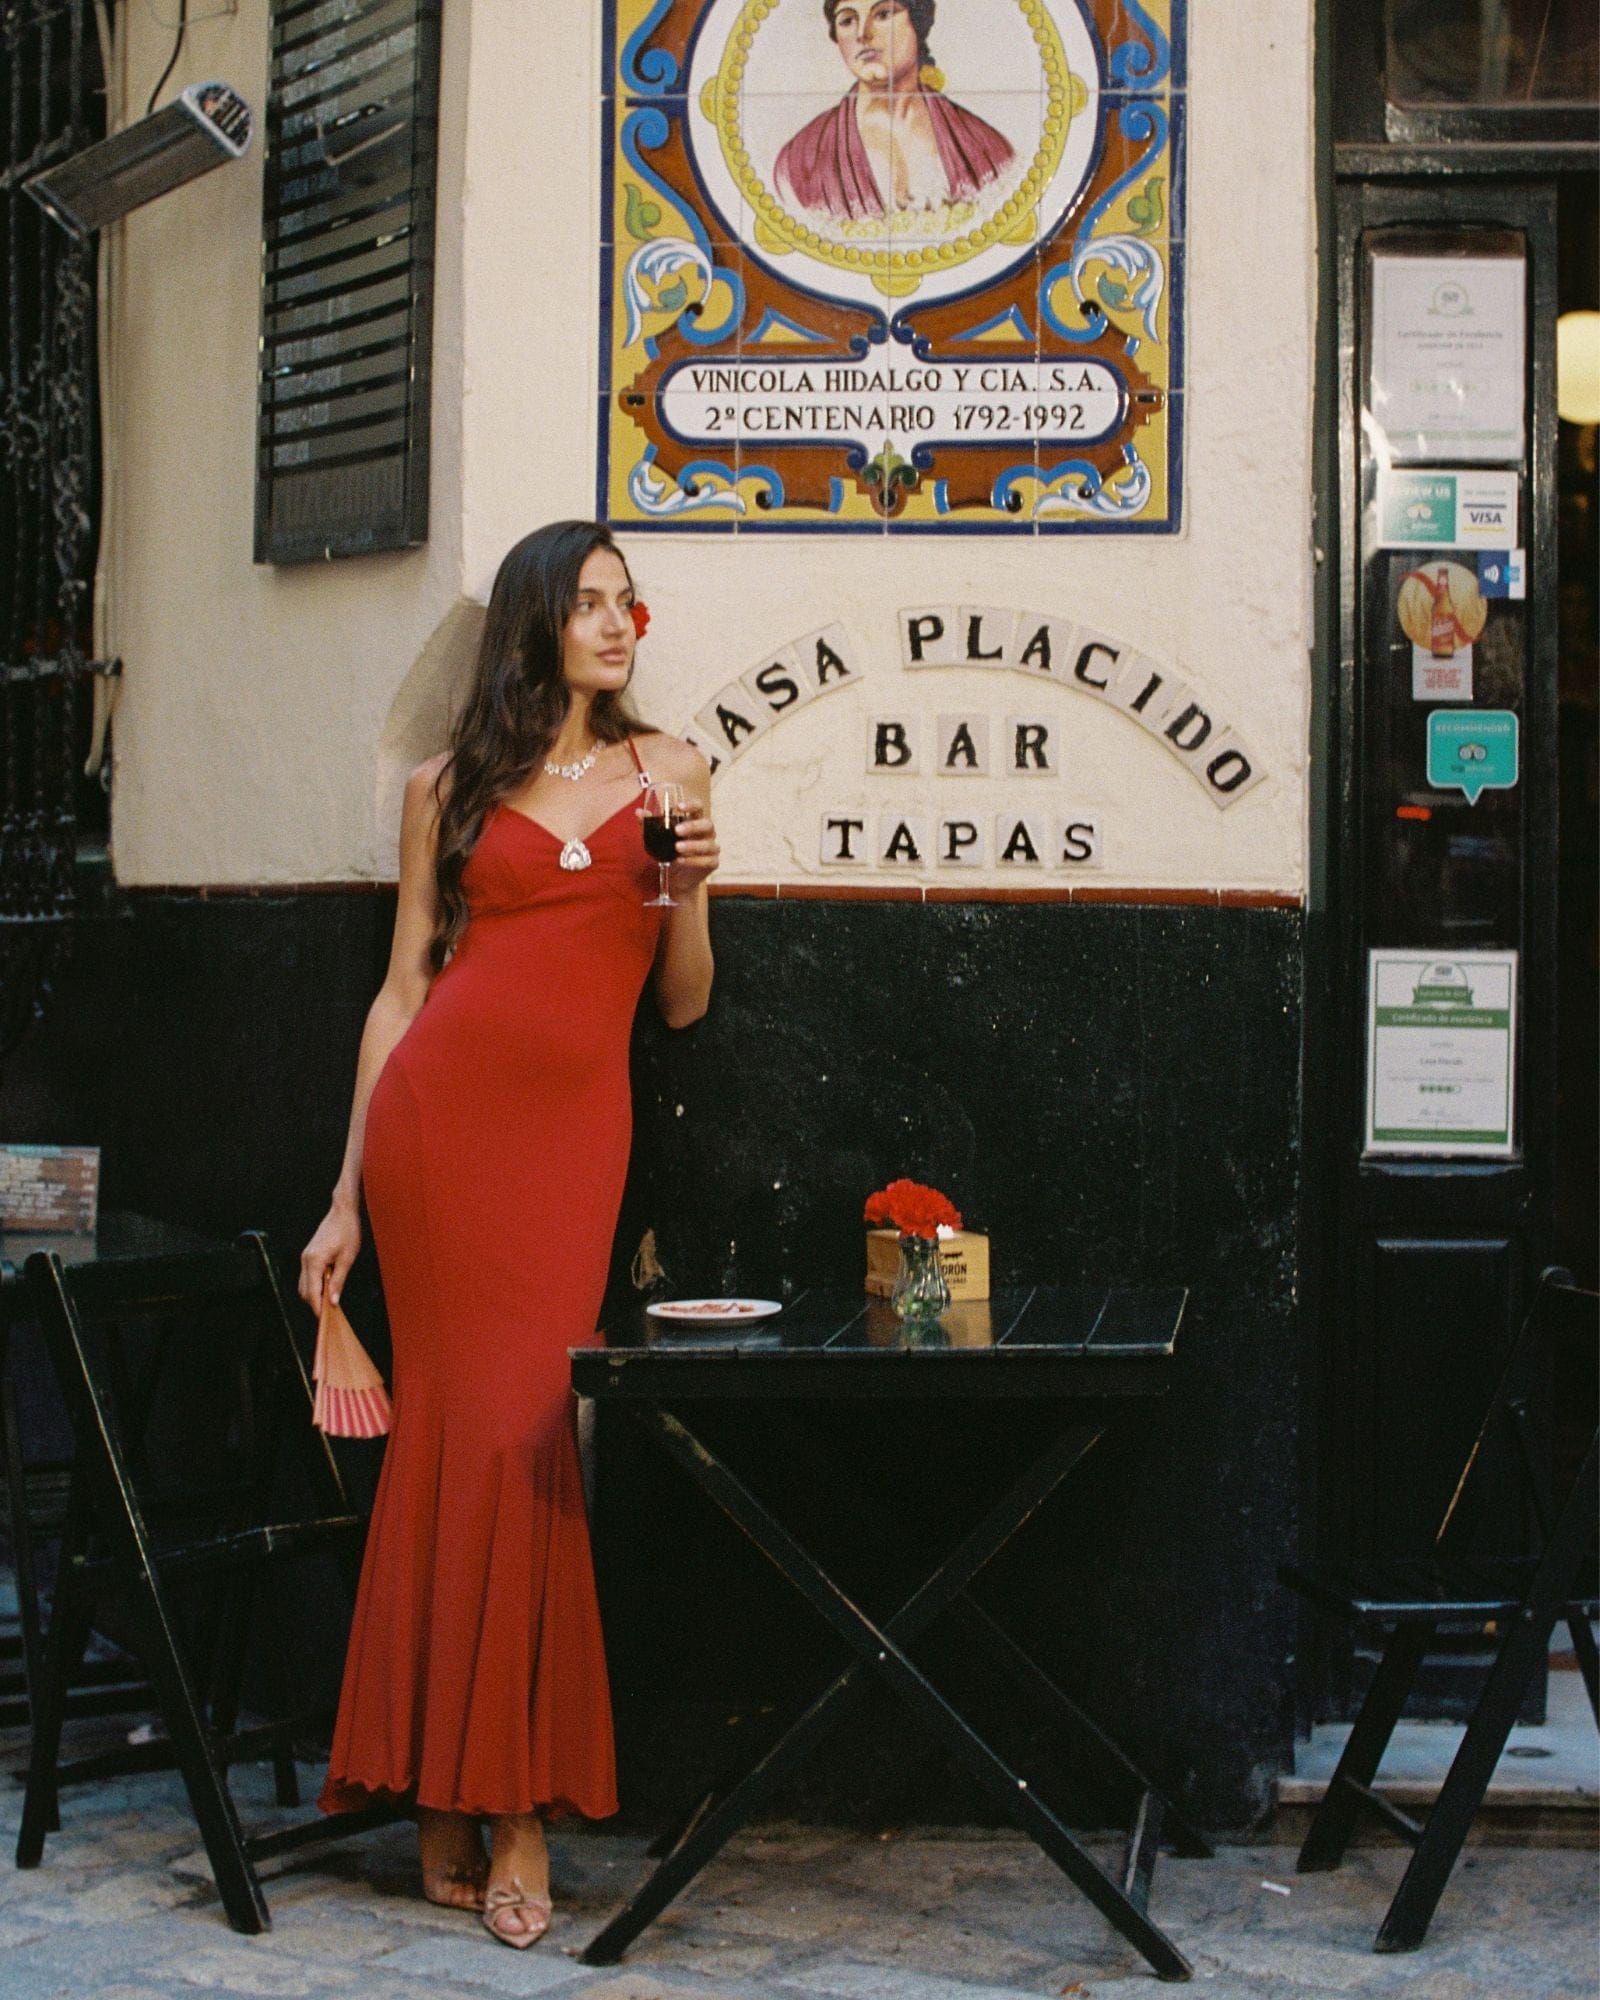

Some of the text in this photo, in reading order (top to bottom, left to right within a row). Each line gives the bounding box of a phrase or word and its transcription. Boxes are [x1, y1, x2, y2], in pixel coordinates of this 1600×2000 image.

[691, 368, 1103, 393] VINICOLA HIDALGO Y CIA. S.A.
[743, 405, 935, 433] CENTENARIO
[953, 404, 1084, 431] 1792-1992
[1470, 510, 1502, 523] VISA
[686, 614, 1252, 795] ASA PLACIDO
[873, 722, 1050, 769] BAR
[826, 818, 1095, 863] TAPAS
